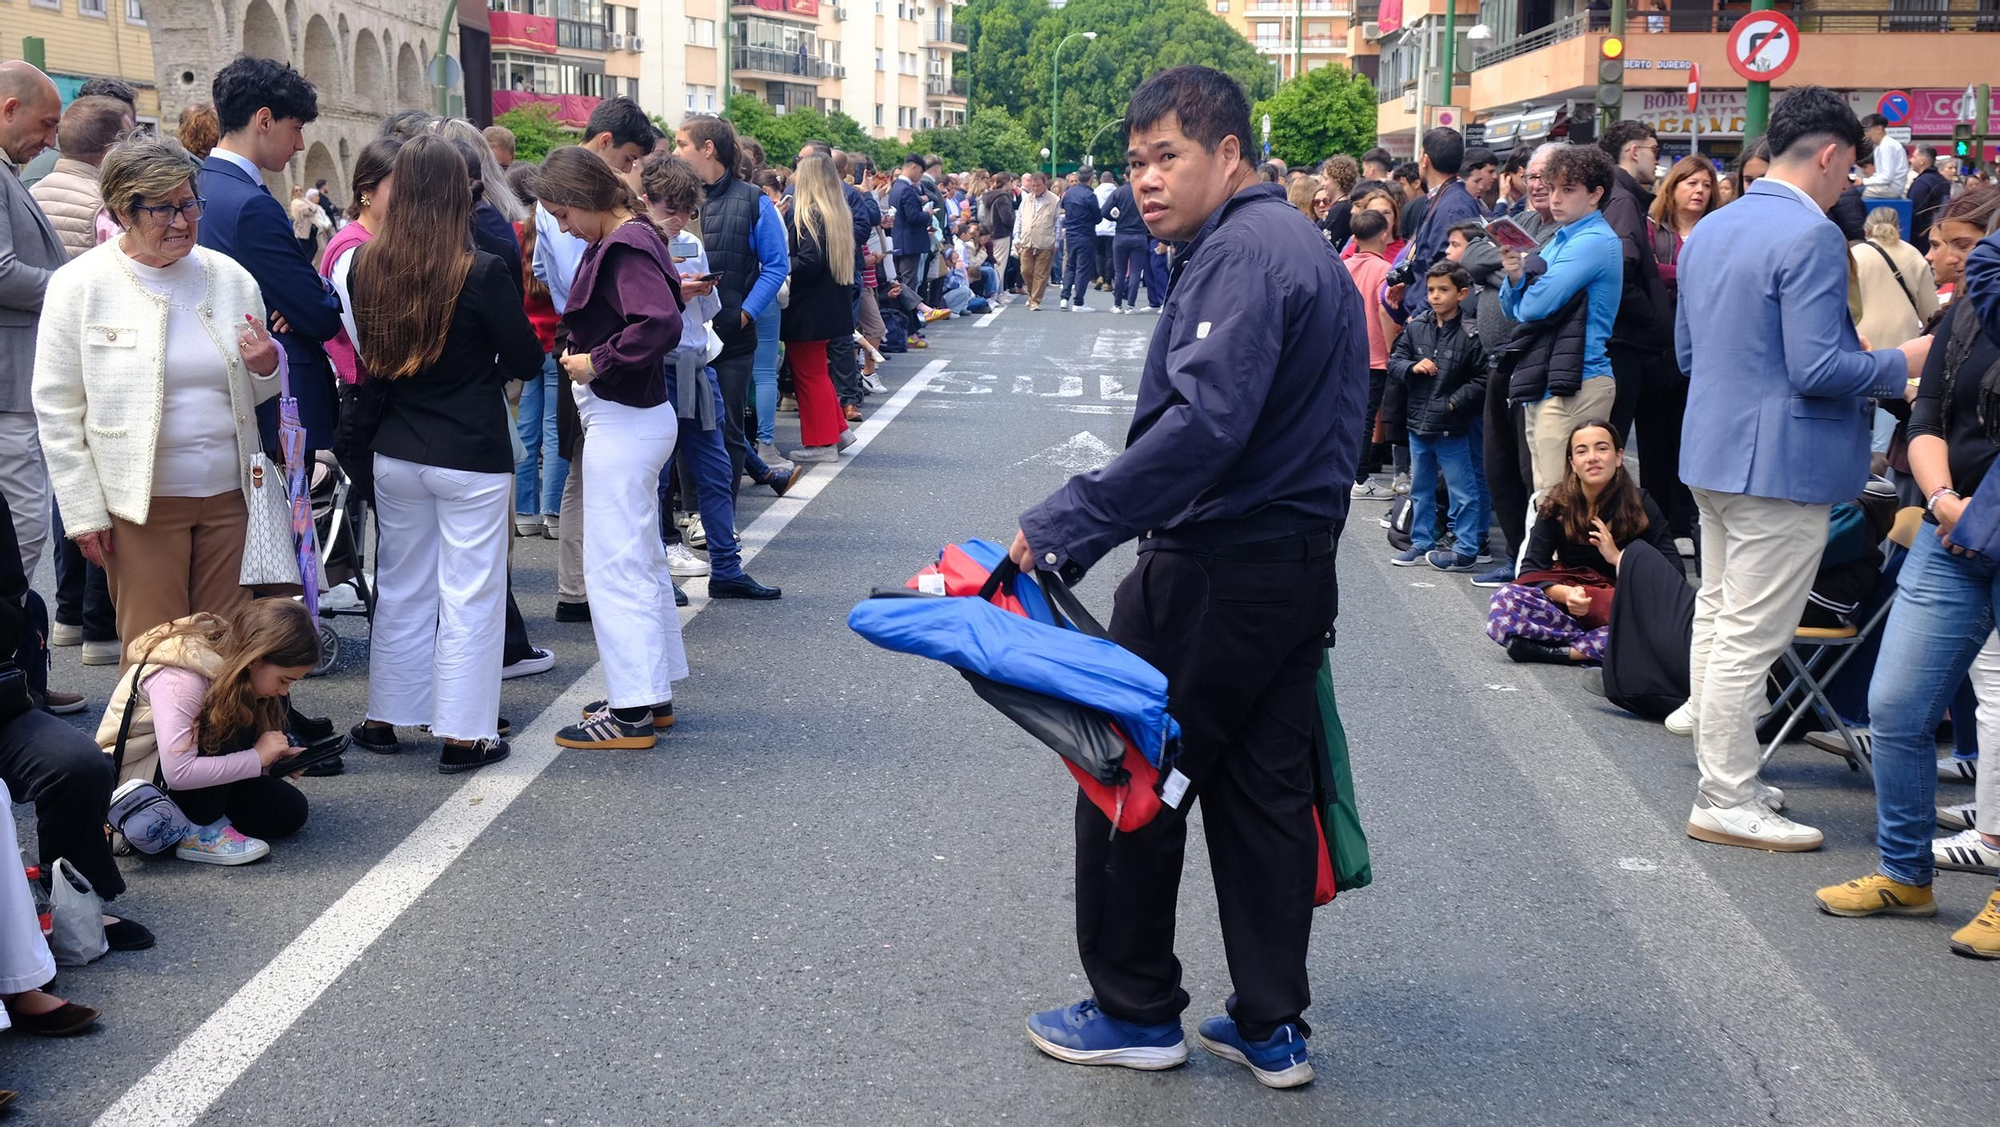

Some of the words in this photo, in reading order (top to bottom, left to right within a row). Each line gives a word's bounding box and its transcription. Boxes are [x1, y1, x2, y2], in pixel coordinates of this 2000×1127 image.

[1624, 60, 1652, 69] BERTO
[1657, 60, 1692, 70] DURERO
[1643, 92, 1736, 110] BODEUITA
